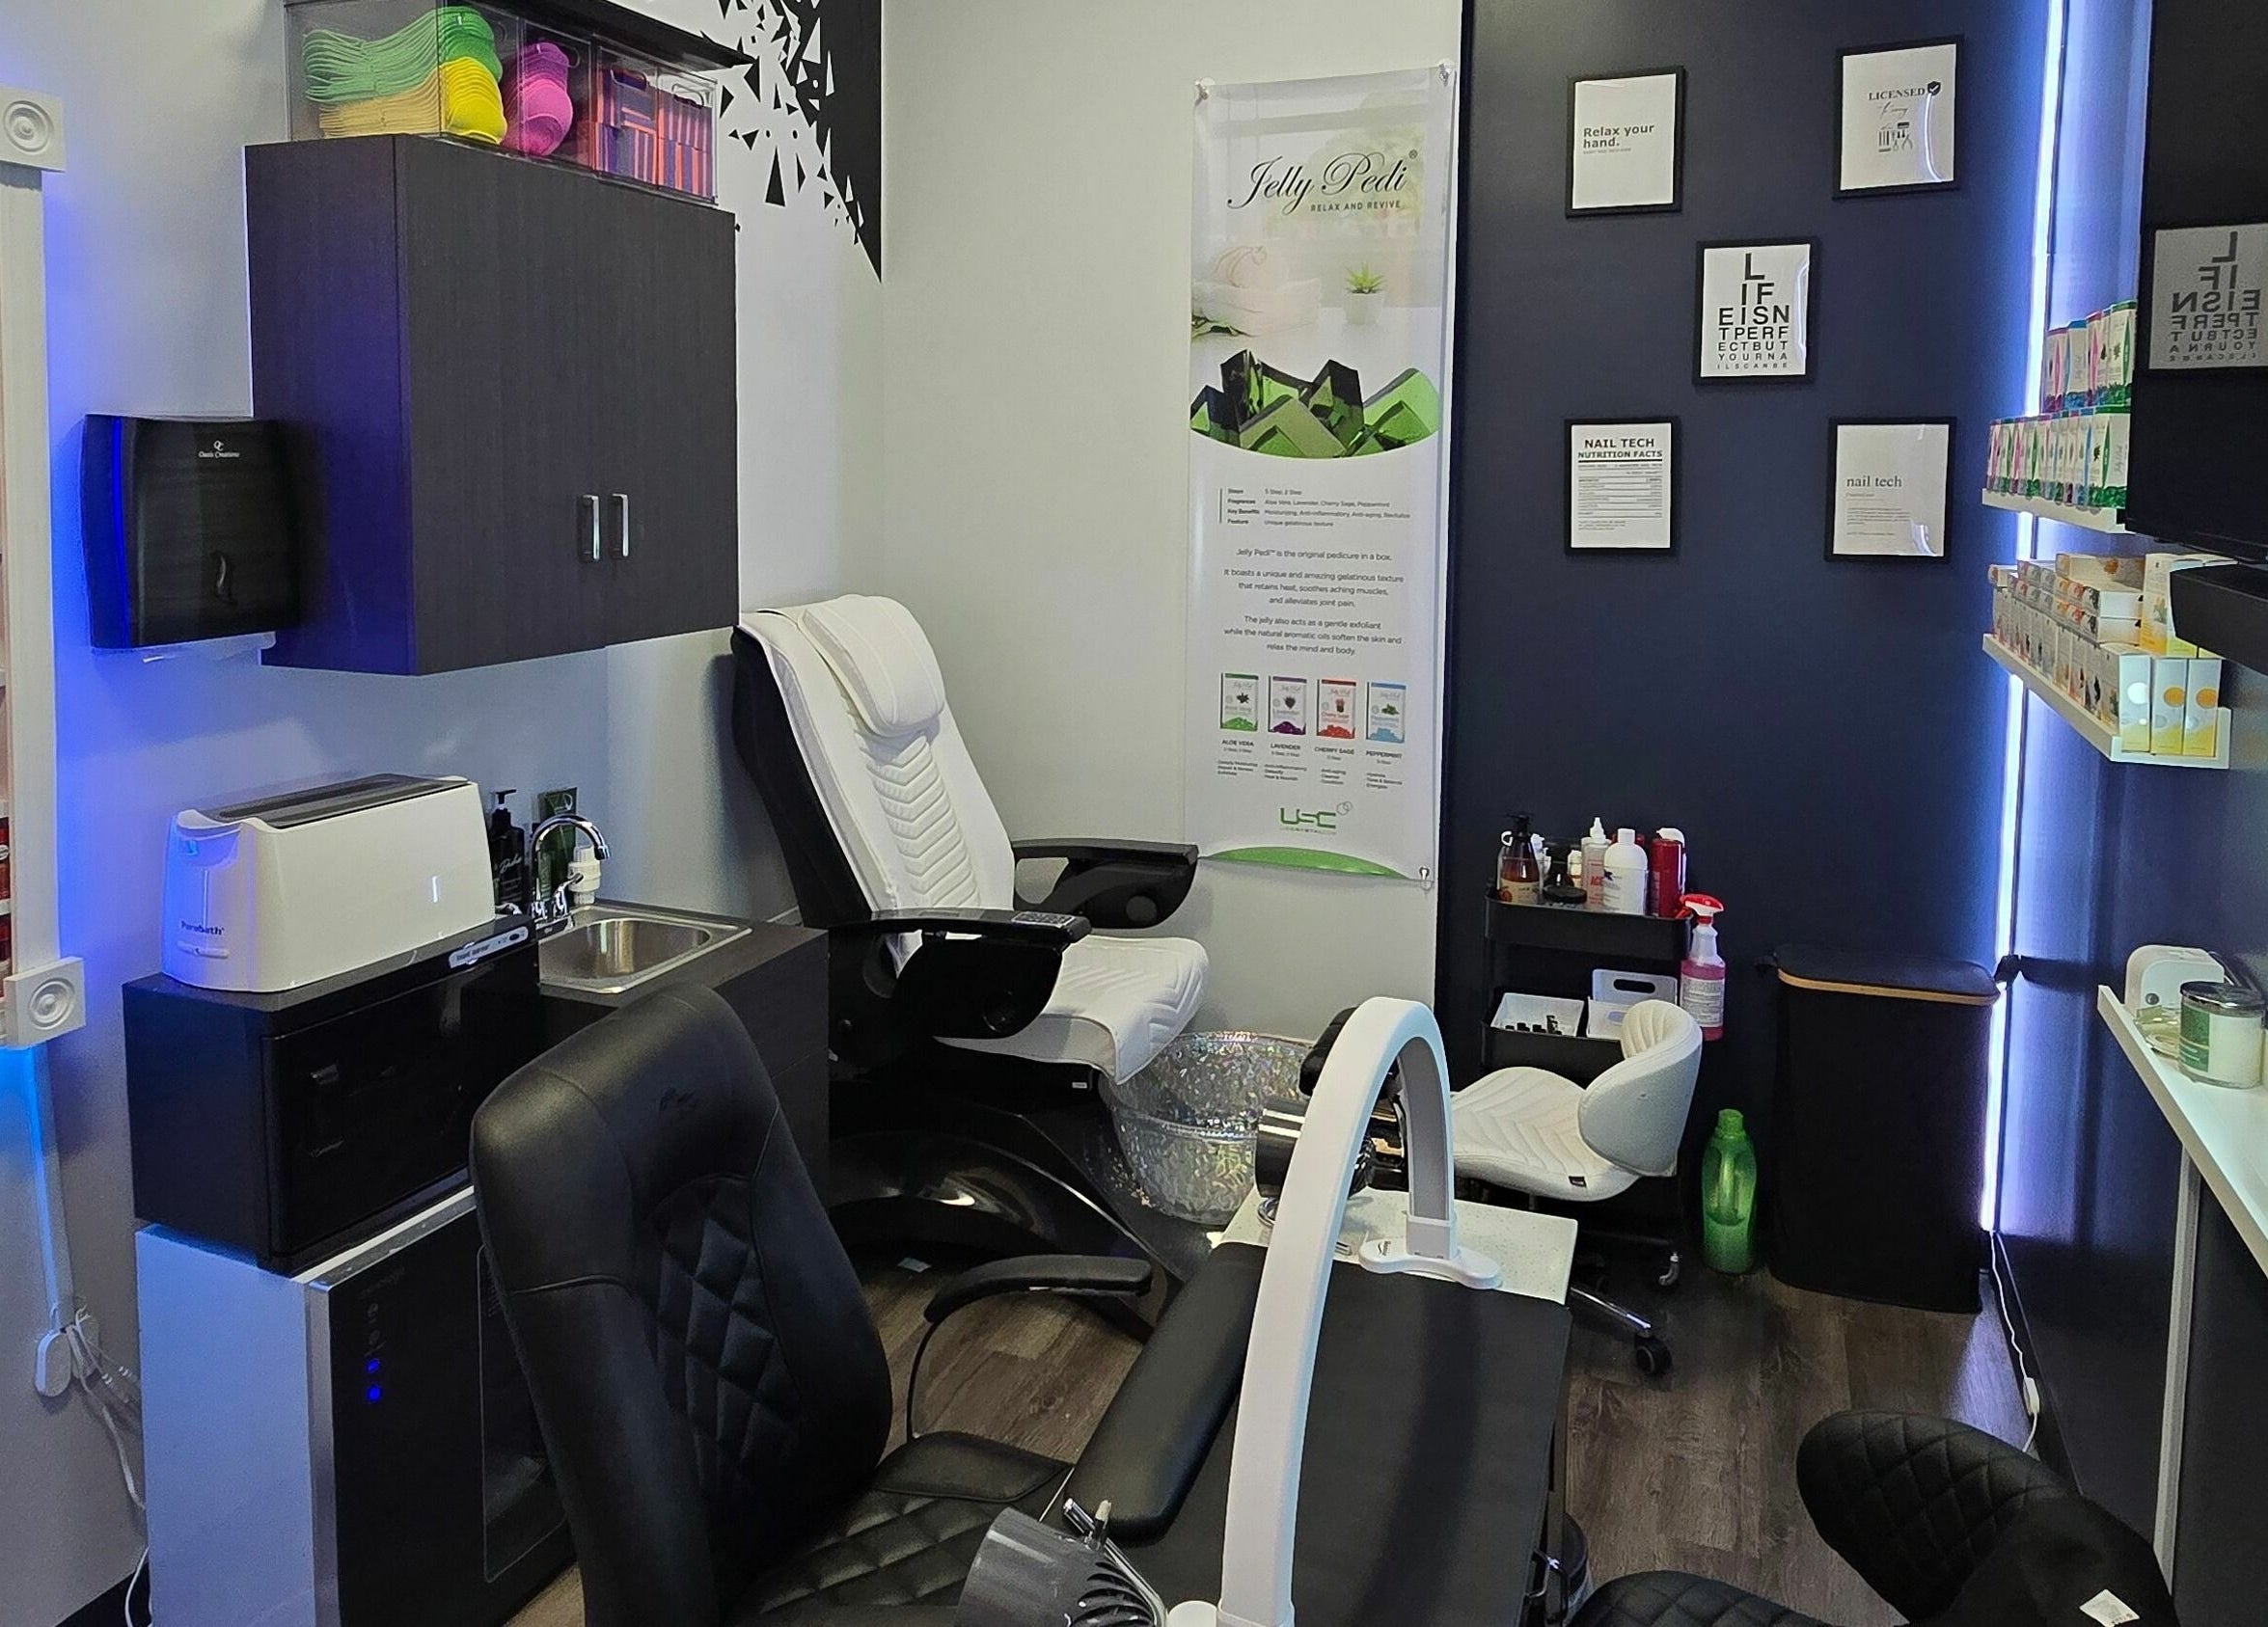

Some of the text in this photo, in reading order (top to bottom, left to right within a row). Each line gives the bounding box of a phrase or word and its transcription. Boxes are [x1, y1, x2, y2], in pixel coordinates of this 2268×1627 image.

[1869, 88, 1926, 100] LICENSED
[1583, 124, 1654, 137] Relax your
[1583, 137, 1620, 149] hand.
[1227, 155, 1314, 216] Jelly
[1310, 201, 1401, 212] RELAX AND REVIVE
[1744, 253, 1765, 281] L
[1718, 305, 1790, 326] EISN
[1718, 326, 1790, 340] TPERF
[1718, 340, 1788, 351] ECTBUT
[1718, 352, 1788, 361] YOURNA
[1584, 438, 1654, 448] NAIL TECH
[1633, 449, 1663, 458] FACTS
[1846, 475, 1902, 487] nail tech
[1236, 548, 1252, 557] Jelly
[1303, 572, 1335, 581] amazing
[1329, 586, 1354, 595] aching
[1258, 616, 1273, 625] jelly
[1280, 807, 1336, 828] USC
